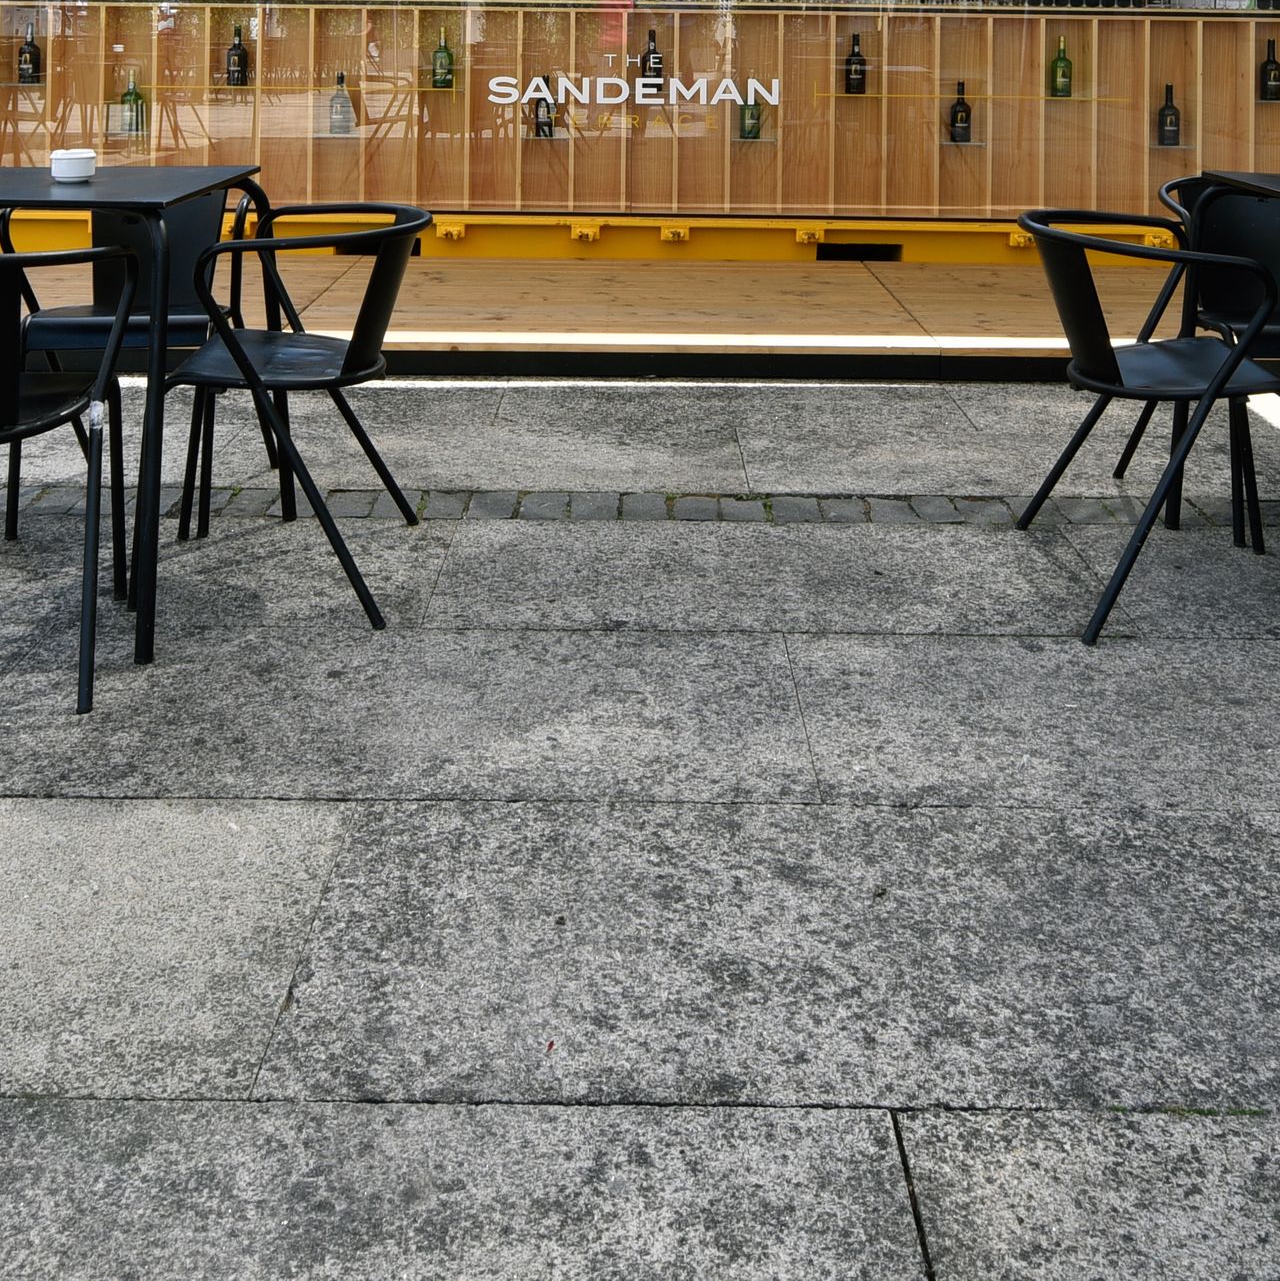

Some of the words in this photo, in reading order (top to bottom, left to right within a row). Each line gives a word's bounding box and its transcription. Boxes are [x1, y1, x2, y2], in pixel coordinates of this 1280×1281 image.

[604, 54, 663, 68] THE
[487, 76, 780, 106] SANDEMAN
[546, 114, 719, 128] TERRACE
